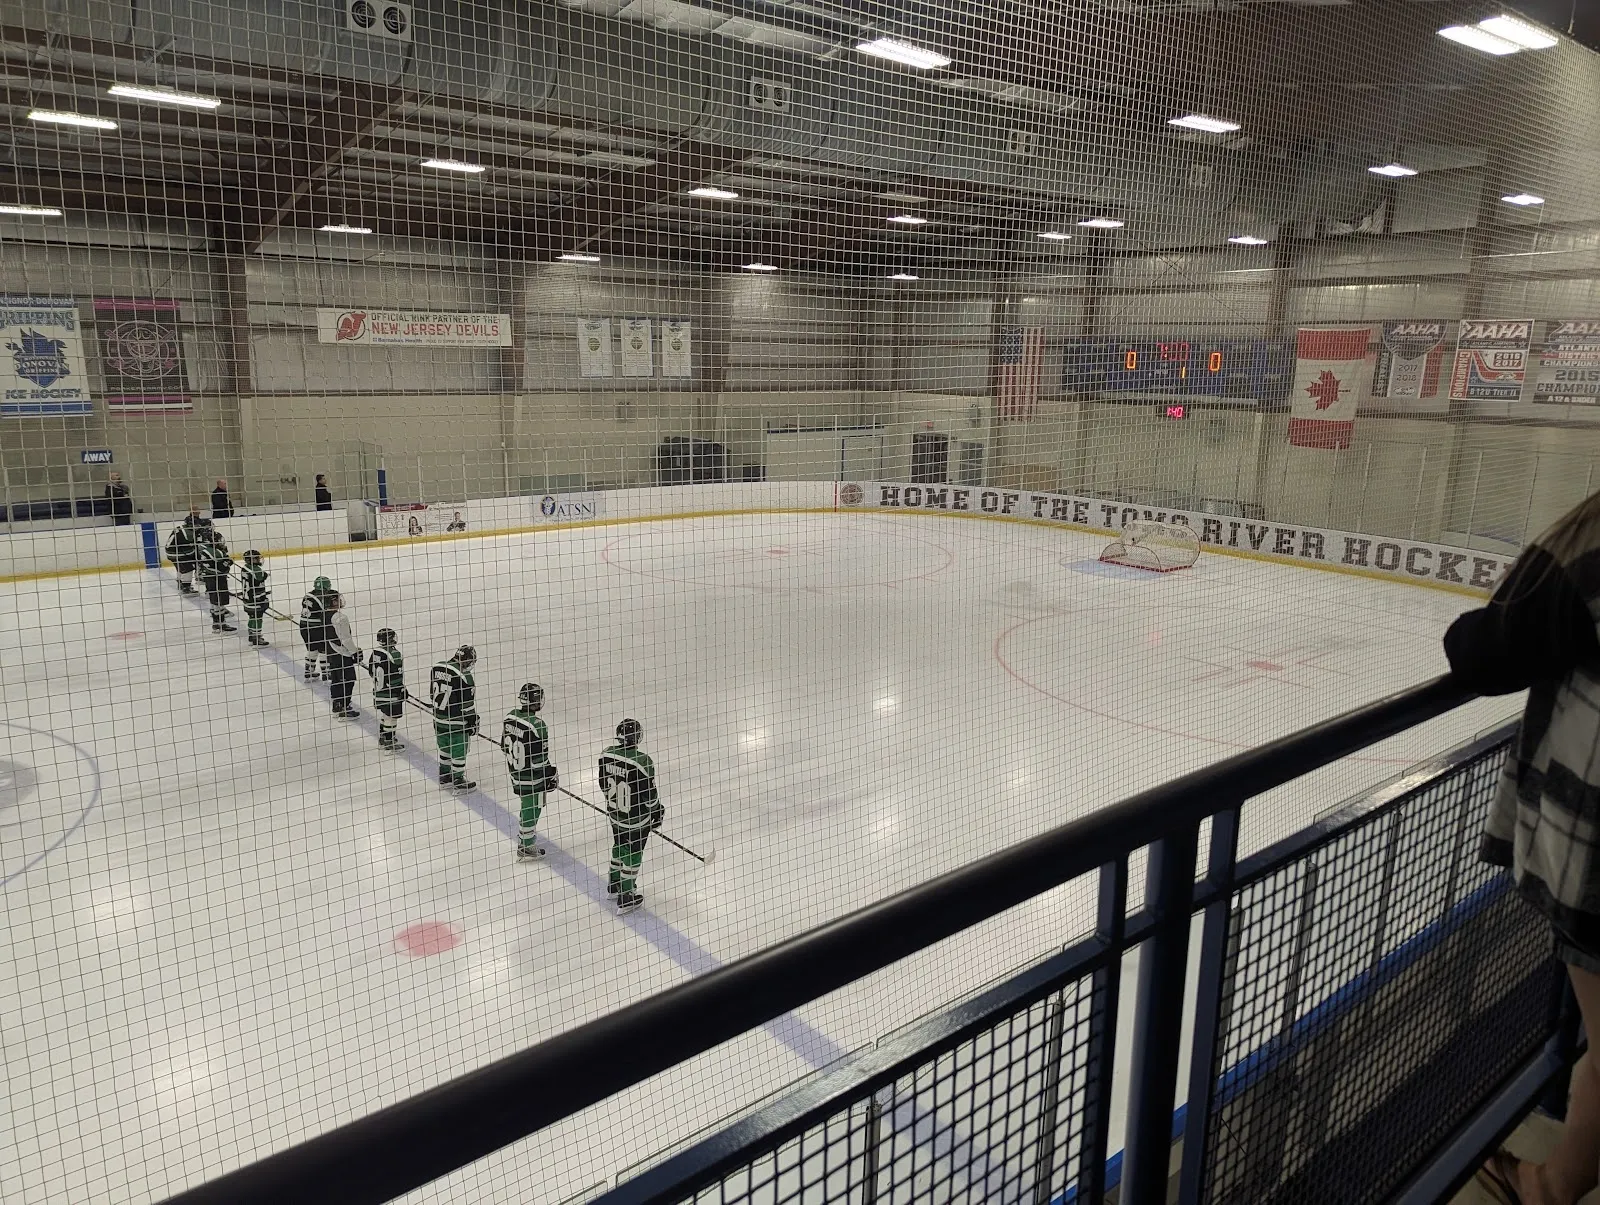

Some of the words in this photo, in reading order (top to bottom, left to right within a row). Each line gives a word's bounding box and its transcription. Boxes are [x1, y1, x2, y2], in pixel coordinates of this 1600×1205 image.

[371, 312, 410, 322] OFFICIAL
[411, 314, 430, 323] RINK
[432, 314, 469, 324] PARTNER
[471, 315, 480, 324] OF
[483, 315, 498, 324] THE
[371, 321, 398, 335] NEW
[403, 322, 451, 336] JERSEY
[456, 324, 499, 336] DEVILS
[1390, 324, 1440, 335] AAHA
[1466, 323, 1528, 338] AAHA
[15, 361, 70, 369] DONOVAN
[1126, 351, 1137, 369] 0
[1209, 352, 1221, 371] 0
[1398, 364, 1418, 372] 2017
[1452, 351, 1471, 398] CHAMPIONS
[1555, 369, 1599, 381] 2015
[5, 389, 27, 400] ICE
[30, 388, 81, 399] HOCKEY
[83, 452, 112, 463] AWAY
[557, 502, 596, 518] ATSNJ
[880, 485, 970, 511] HOME
[981, 491, 1019, 514] OF
[1031, 495, 1090, 525] THE
[1200, 518, 1326, 560] RIVER
[432, 681, 453, 711] 27
[607, 777, 631, 814] 20
